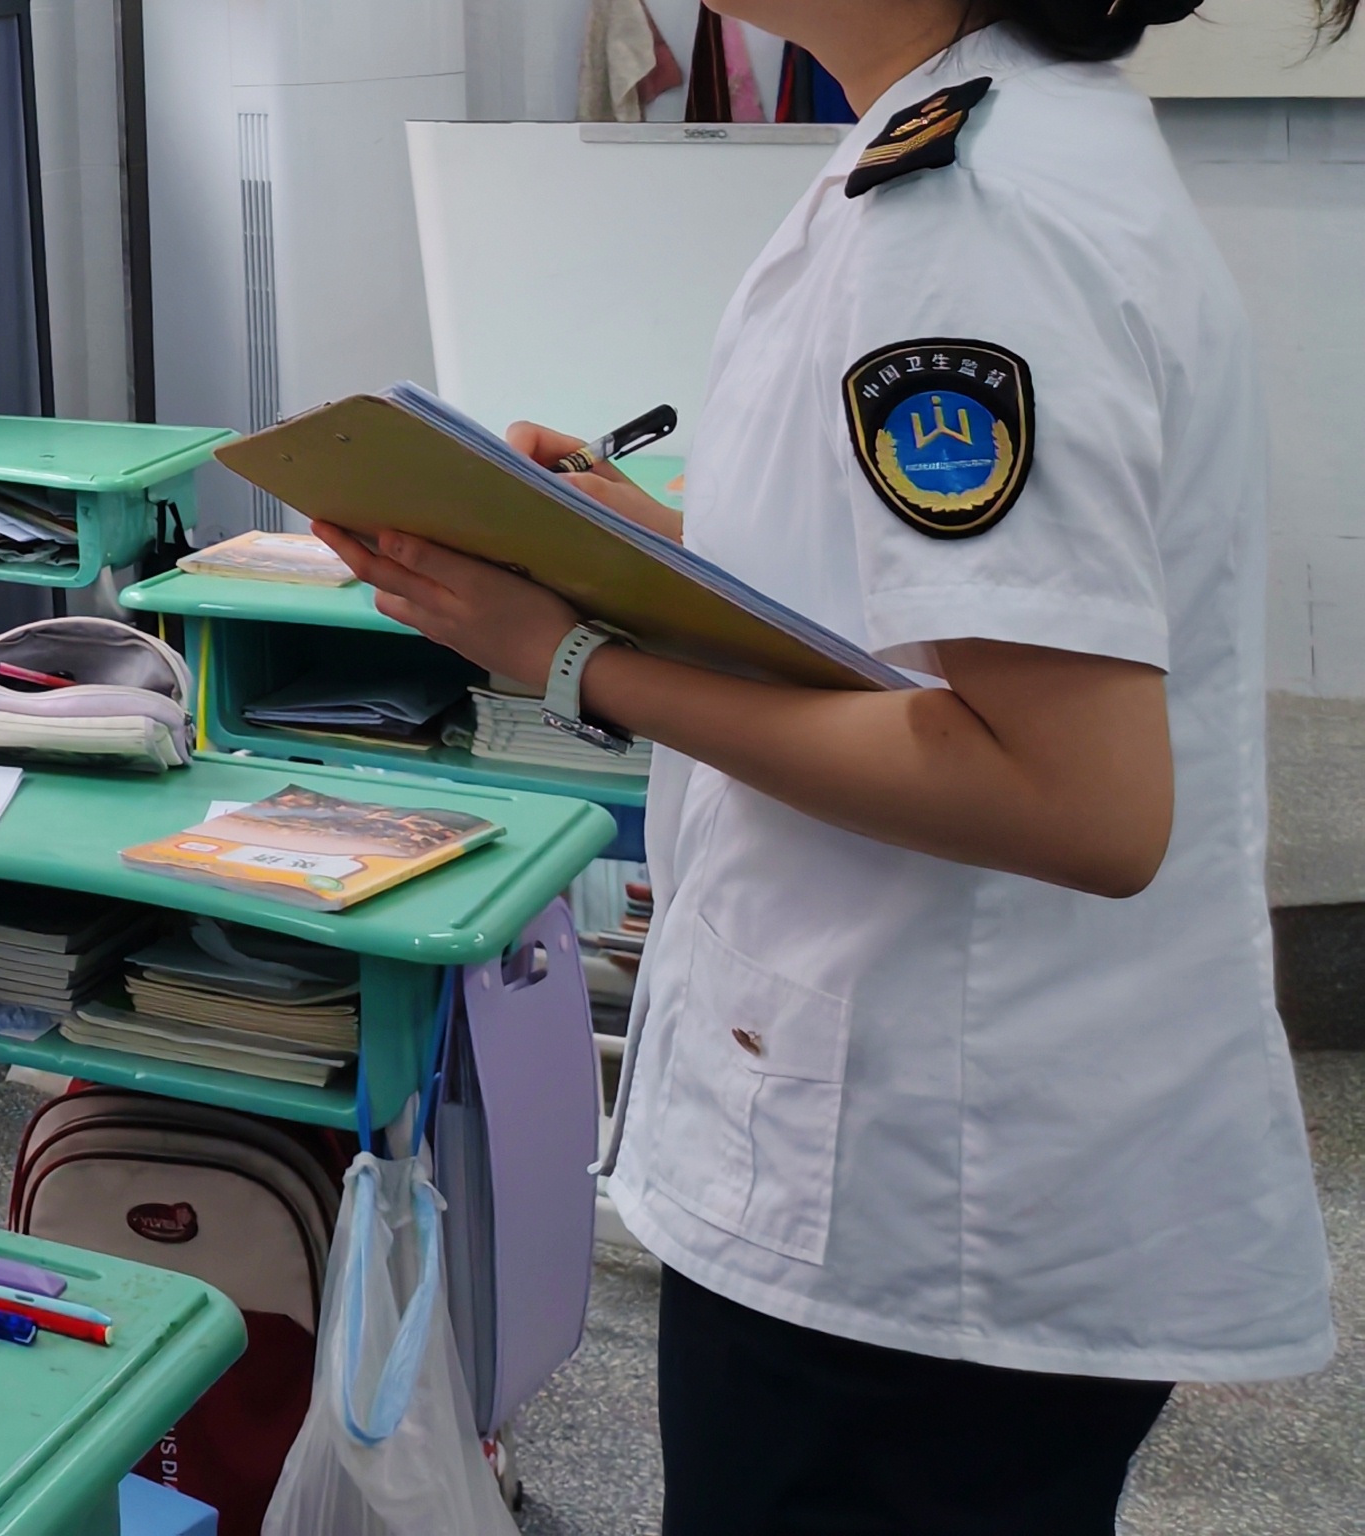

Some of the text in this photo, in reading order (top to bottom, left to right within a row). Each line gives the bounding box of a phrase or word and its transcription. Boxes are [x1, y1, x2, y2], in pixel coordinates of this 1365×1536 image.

[861, 353, 1007, 399] 中国卫生监督
